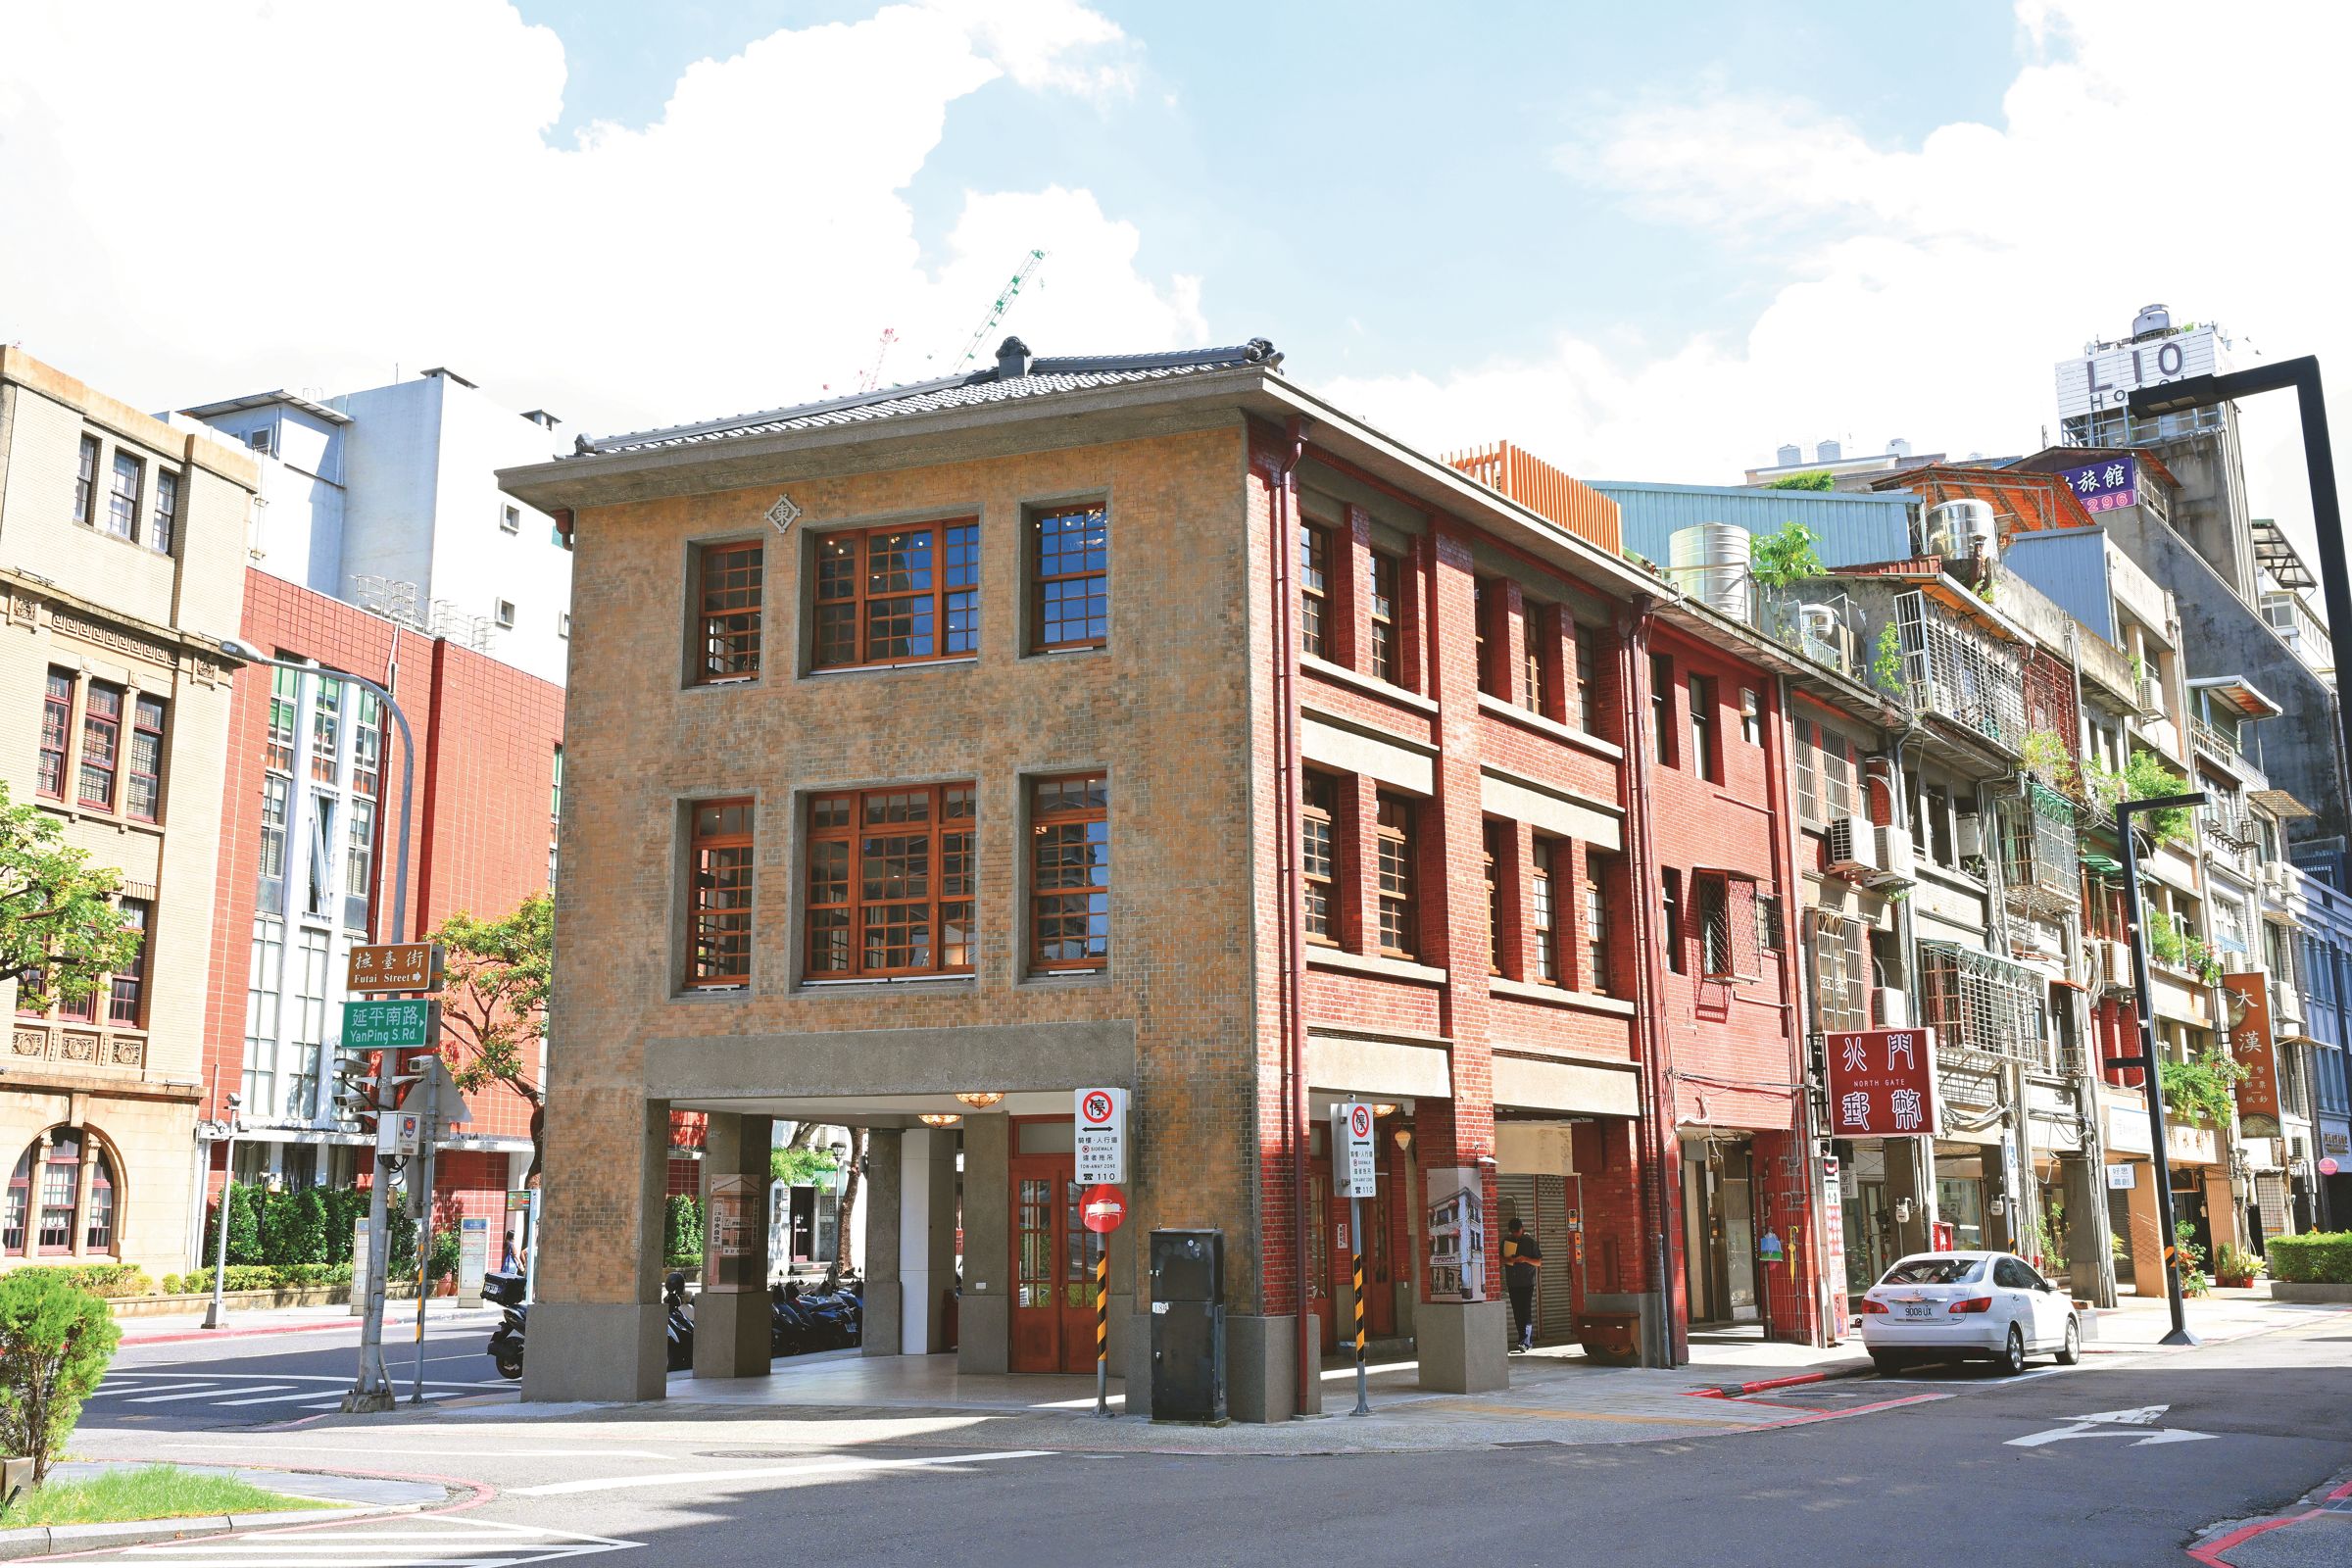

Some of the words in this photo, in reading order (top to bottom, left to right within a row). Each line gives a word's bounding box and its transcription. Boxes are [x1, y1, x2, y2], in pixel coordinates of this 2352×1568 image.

[2086, 343, 2183, 393] LIO
[2082, 492, 2128, 513] 296
[775, 503, 790, 525] 東
[355, 949, 423, 970] 撫臺街
[354, 973, 377, 983] Futai
[383, 973, 410, 983] Street
[352, 1004, 418, 1027] 延平南路
[2234, 988, 2262, 1054] 大漢
[350, 1029, 389, 1045] YanPing
[1089, 1099, 1105, 1116] 停
